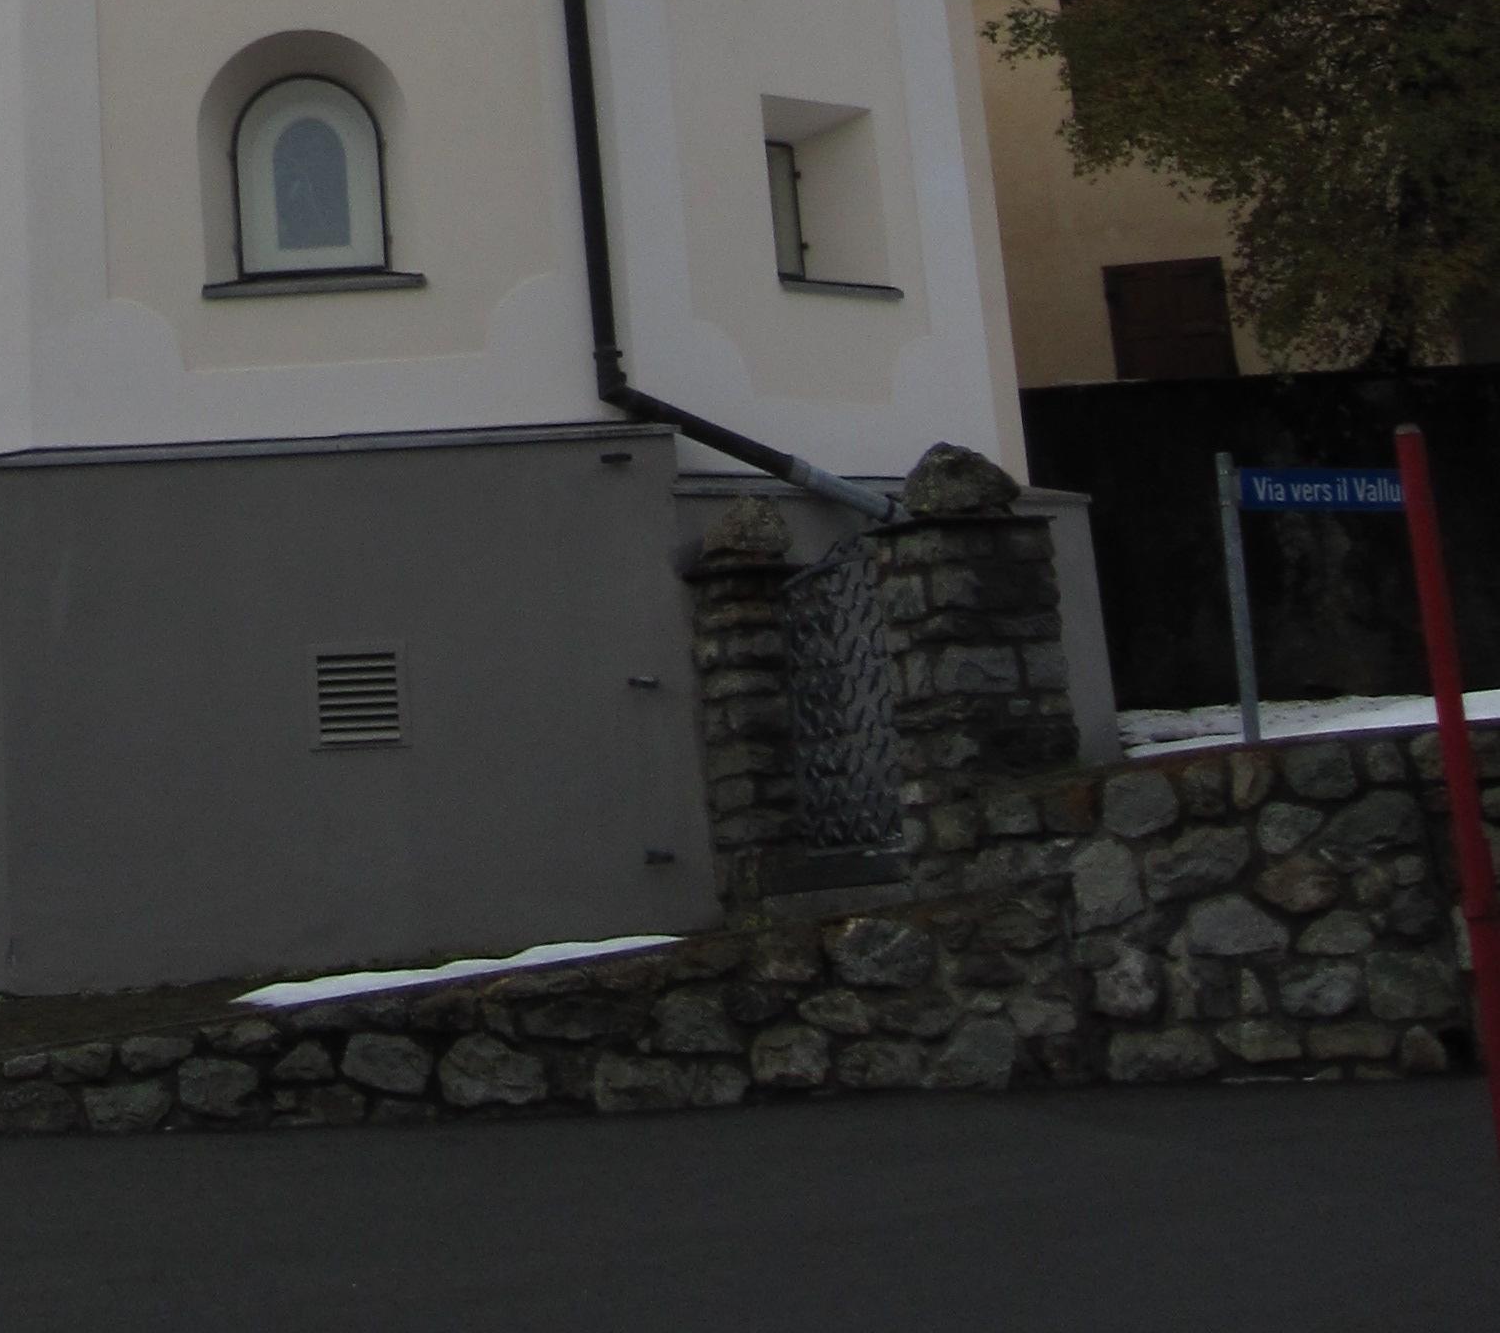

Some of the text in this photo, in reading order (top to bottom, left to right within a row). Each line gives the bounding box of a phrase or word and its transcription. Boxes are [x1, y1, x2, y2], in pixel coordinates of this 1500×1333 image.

[1252, 476, 1404, 502] Via vers il Vallu
